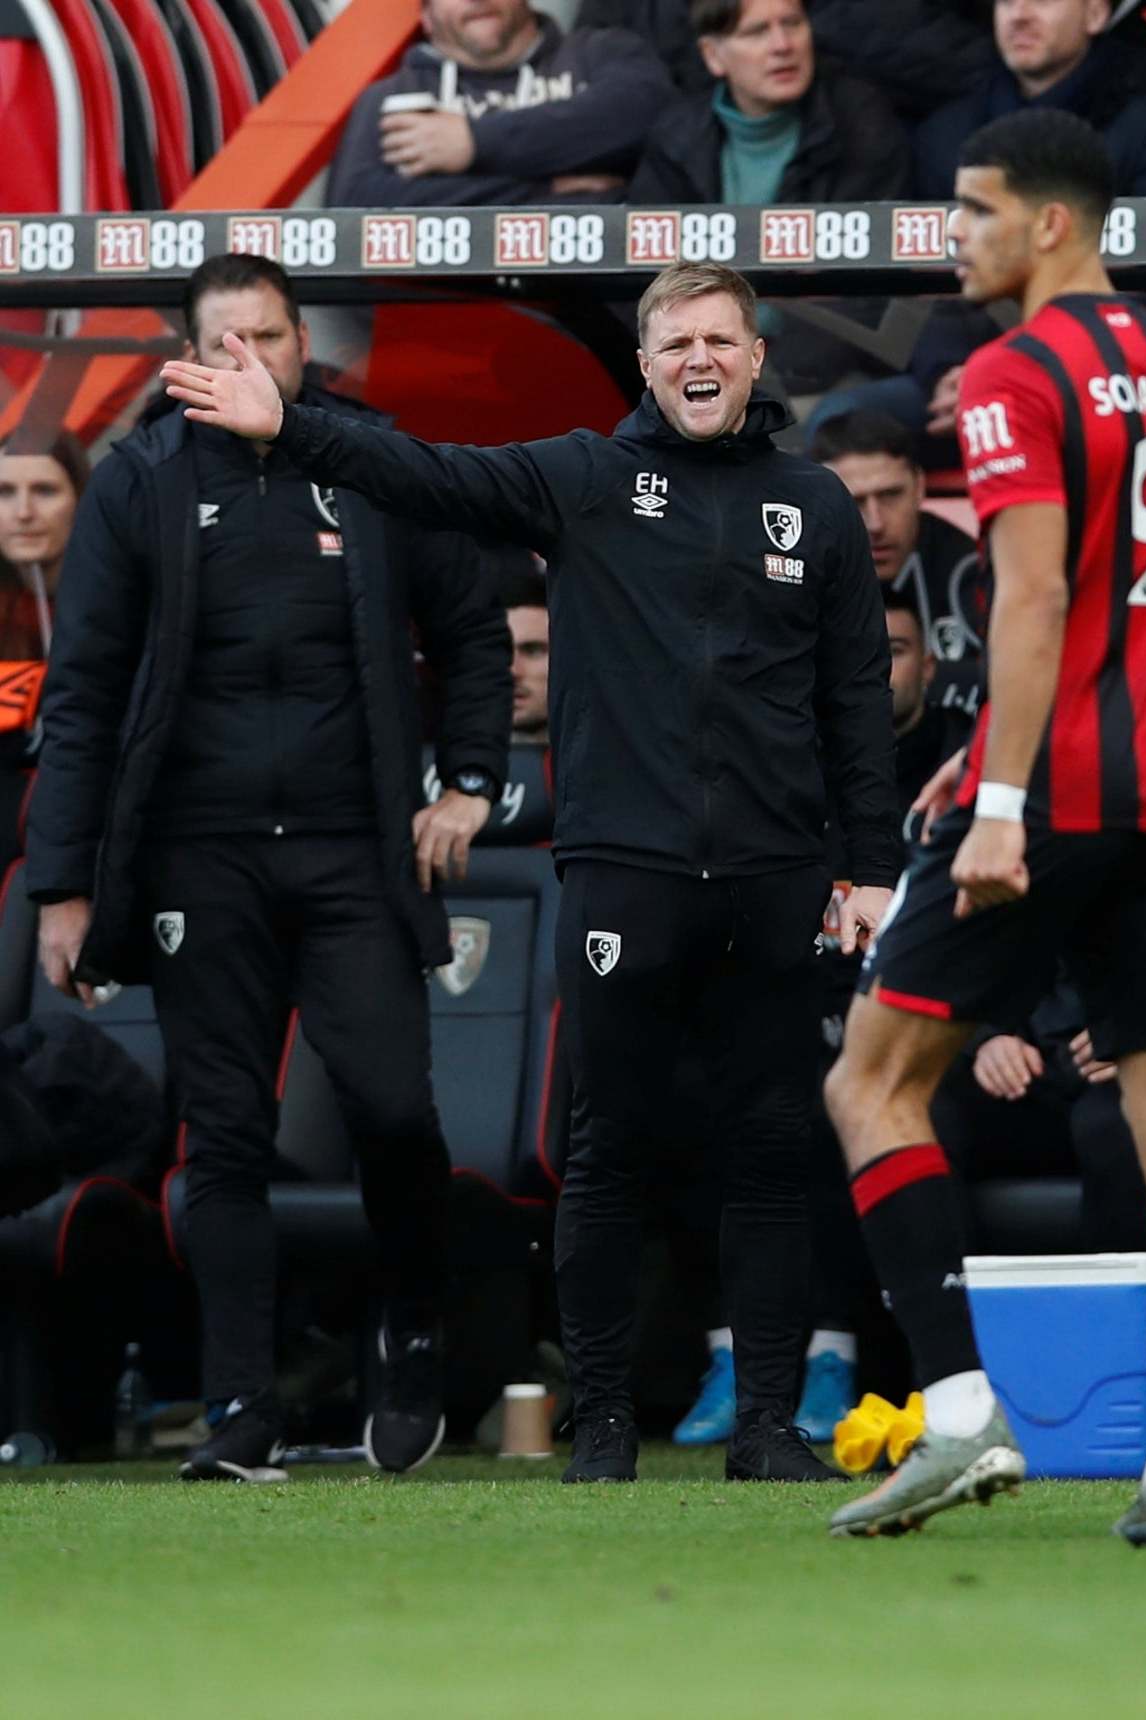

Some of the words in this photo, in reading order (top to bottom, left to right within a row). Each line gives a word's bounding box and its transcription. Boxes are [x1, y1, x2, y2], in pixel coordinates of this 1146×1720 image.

[99, 219, 205, 271] M88
[365, 215, 471, 265] M88
[498, 214, 604, 264] M88
[630, 212, 736, 263] M88
[764, 210, 870, 261] M88
[635, 472, 669, 495] EH
[633, 507, 665, 519] umbro
[765, 556, 804, 578] M88
